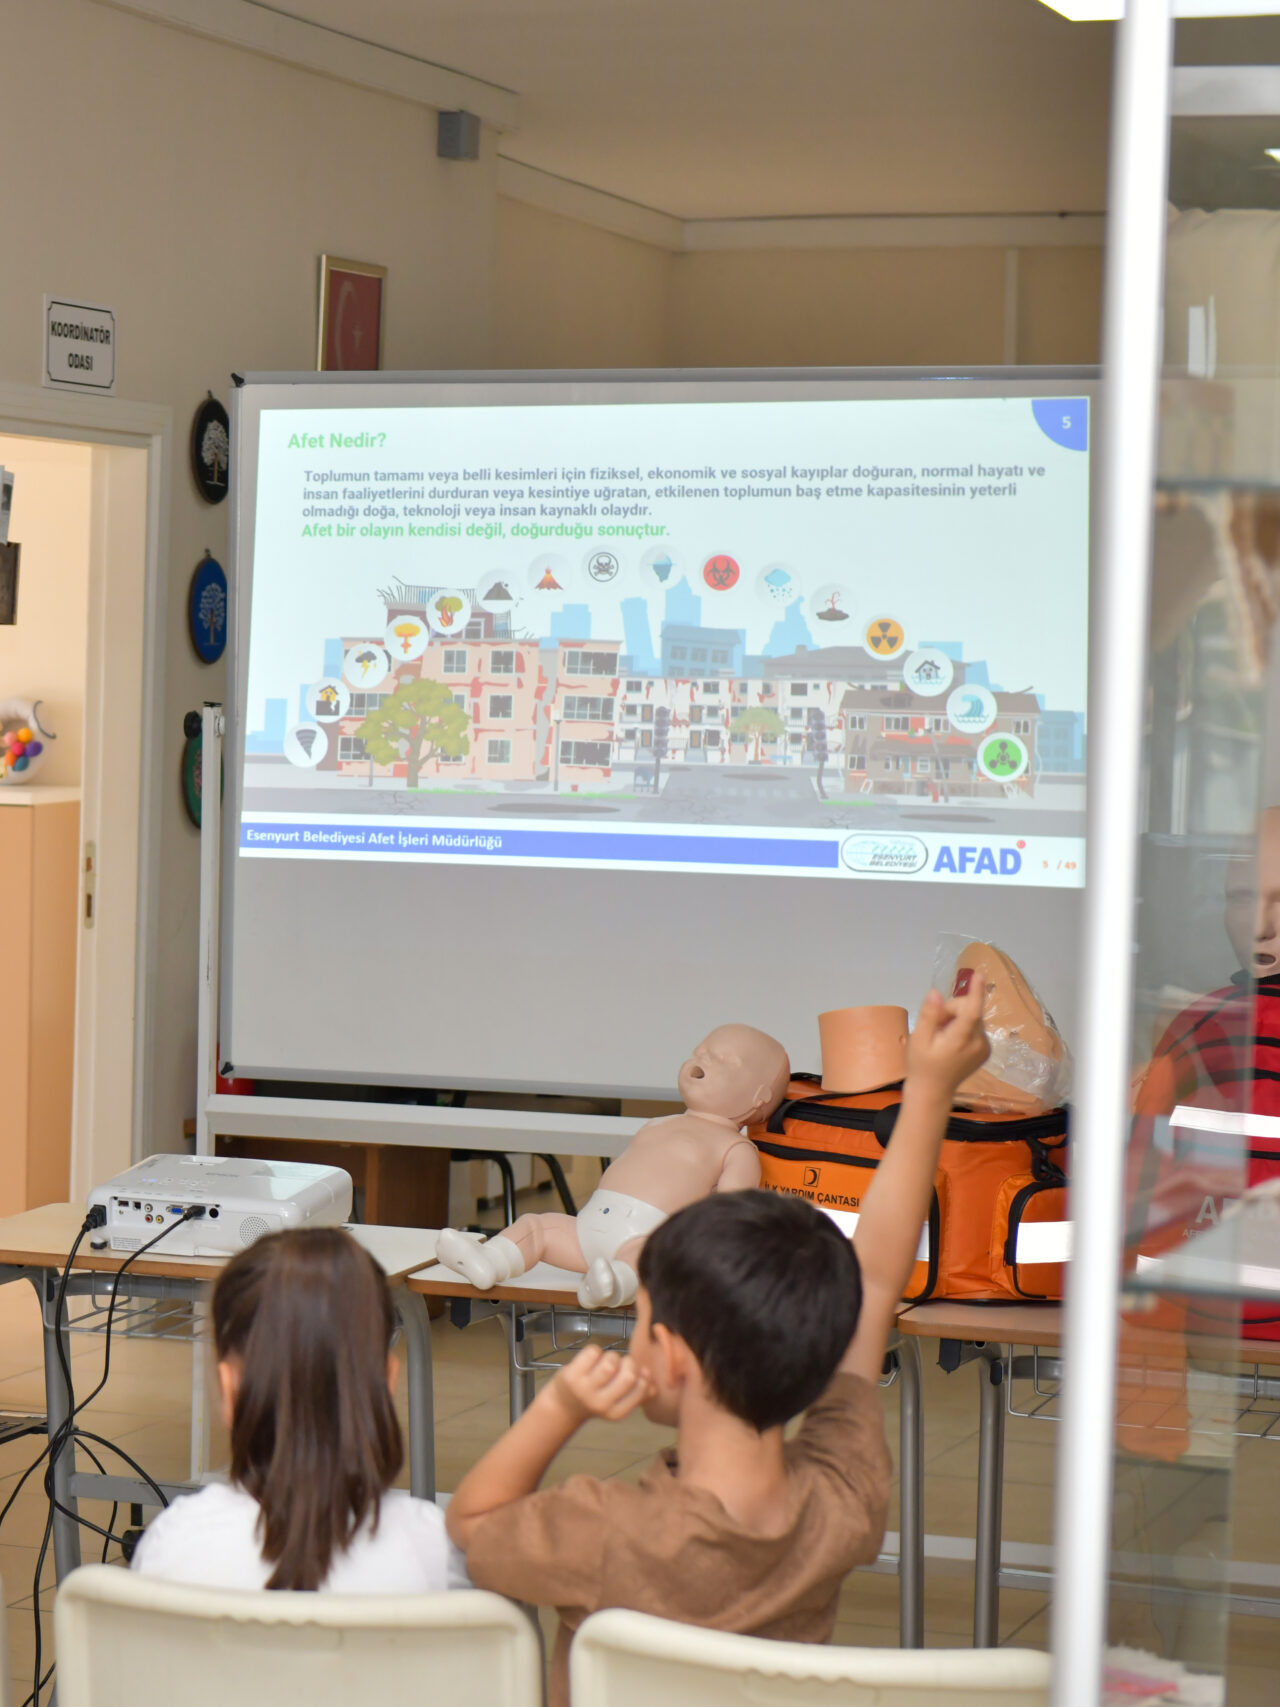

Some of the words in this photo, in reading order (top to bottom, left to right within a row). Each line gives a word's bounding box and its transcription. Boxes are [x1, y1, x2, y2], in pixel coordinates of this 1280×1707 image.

[51, 321, 111, 345] KOORDİNATÖR
[68, 352, 93, 371] ODASI
[1062, 416, 1071, 429] 5
[288, 433, 324, 448] Afet
[330, 432, 386, 448] Nedir?
[304, 470, 370, 484] Toplumun
[374, 471, 424, 481] tamamı
[428, 472, 458, 484] veya
[463, 468, 491, 480] belli
[495, 468, 557, 480] kesimleri
[562, 467, 586, 483] için
[590, 467, 643, 481] fiziksel,
[648, 466, 716, 479] ekonomik
[721, 469, 737, 479] ve
[741, 466, 787, 481] sosyal
[791, 465, 848, 481] kayıplar
[852, 465, 916, 481] doğuran,
[921, 464, 973, 477] normal
[978, 464, 1023, 480] hayatı
[1028, 467, 1045, 476] ve
[303, 488, 338, 500] insan
[343, 487, 424, 502] faaliyetlerini
[428, 487, 489, 499] durduran
[493, 489, 524, 501] veya
[528, 486, 590, 501] kesintiye
[594, 487, 650, 501] uğratan,
[655, 485, 719, 498] etkilenen
[724, 485, 792, 500] toplumun
[796, 484, 821, 500] baş
[826, 486, 863, 497] etme
[867, 483, 965, 500] kapasitesinin
[970, 483, 1016, 499] yeterli
[302, 504, 359, 519] olmadığı
[363, 504, 399, 520] doğa,
[403, 504, 460, 519] teknoloji
[465, 507, 495, 519] veya
[500, 504, 536, 516] insan
[540, 504, 596, 519] kaynaklı
[601, 504, 652, 518] olaydır.
[302, 523, 332, 536] Afet
[337, 523, 356, 536] bir
[360, 523, 404, 539] olayın
[409, 523, 461, 536] kendisi
[466, 522, 506, 539] değil,
[511, 523, 593, 539] doğurduğu
[598, 523, 670, 539] sonuçtur.
[246, 829, 300, 845] Esenyurt
[303, 830, 366, 846] Belediyesi
[368, 833, 395, 845] Afet
[398, 831, 429, 848] İşleri
[432, 833, 502, 851] Müdürlüğü
[933, 845, 1022, 875] AFAD
[817, 1192, 860, 1207] ÇANTASI
